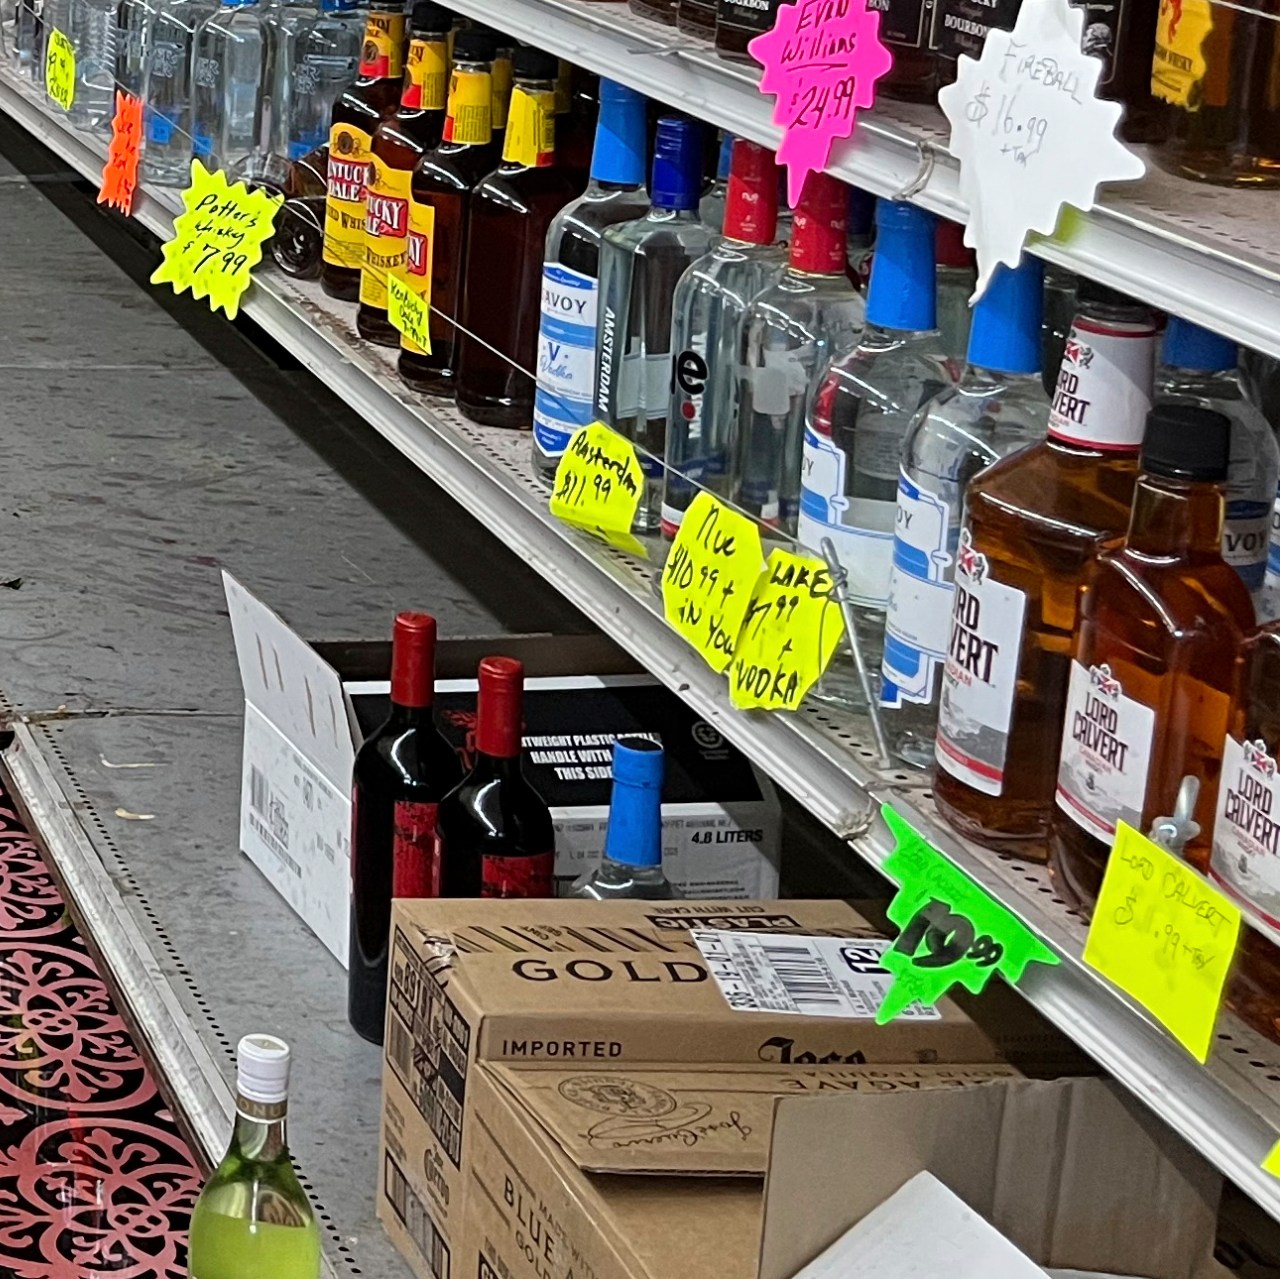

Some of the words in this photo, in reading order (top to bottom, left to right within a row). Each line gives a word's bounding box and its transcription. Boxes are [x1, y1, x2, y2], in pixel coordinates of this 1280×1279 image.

[596, 305, 618, 413] AMSTERDAM
[736, 661, 799, 704] VODKA
[1085, 691, 1118, 735] LORD
[530, 750, 578, 764] HANDLE
[1072, 710, 1129, 773] CALVERT
[554, 767, 585, 781] THIS
[1237, 767, 1274, 815] LORD
[691, 829, 713, 845] 4.8
[715, 828, 764, 845] LITERS
[512, 959, 708, 983] GOLD
[502, 1039, 622, 1057] IMPORTED
[504, 1174, 555, 1266] BLUE
